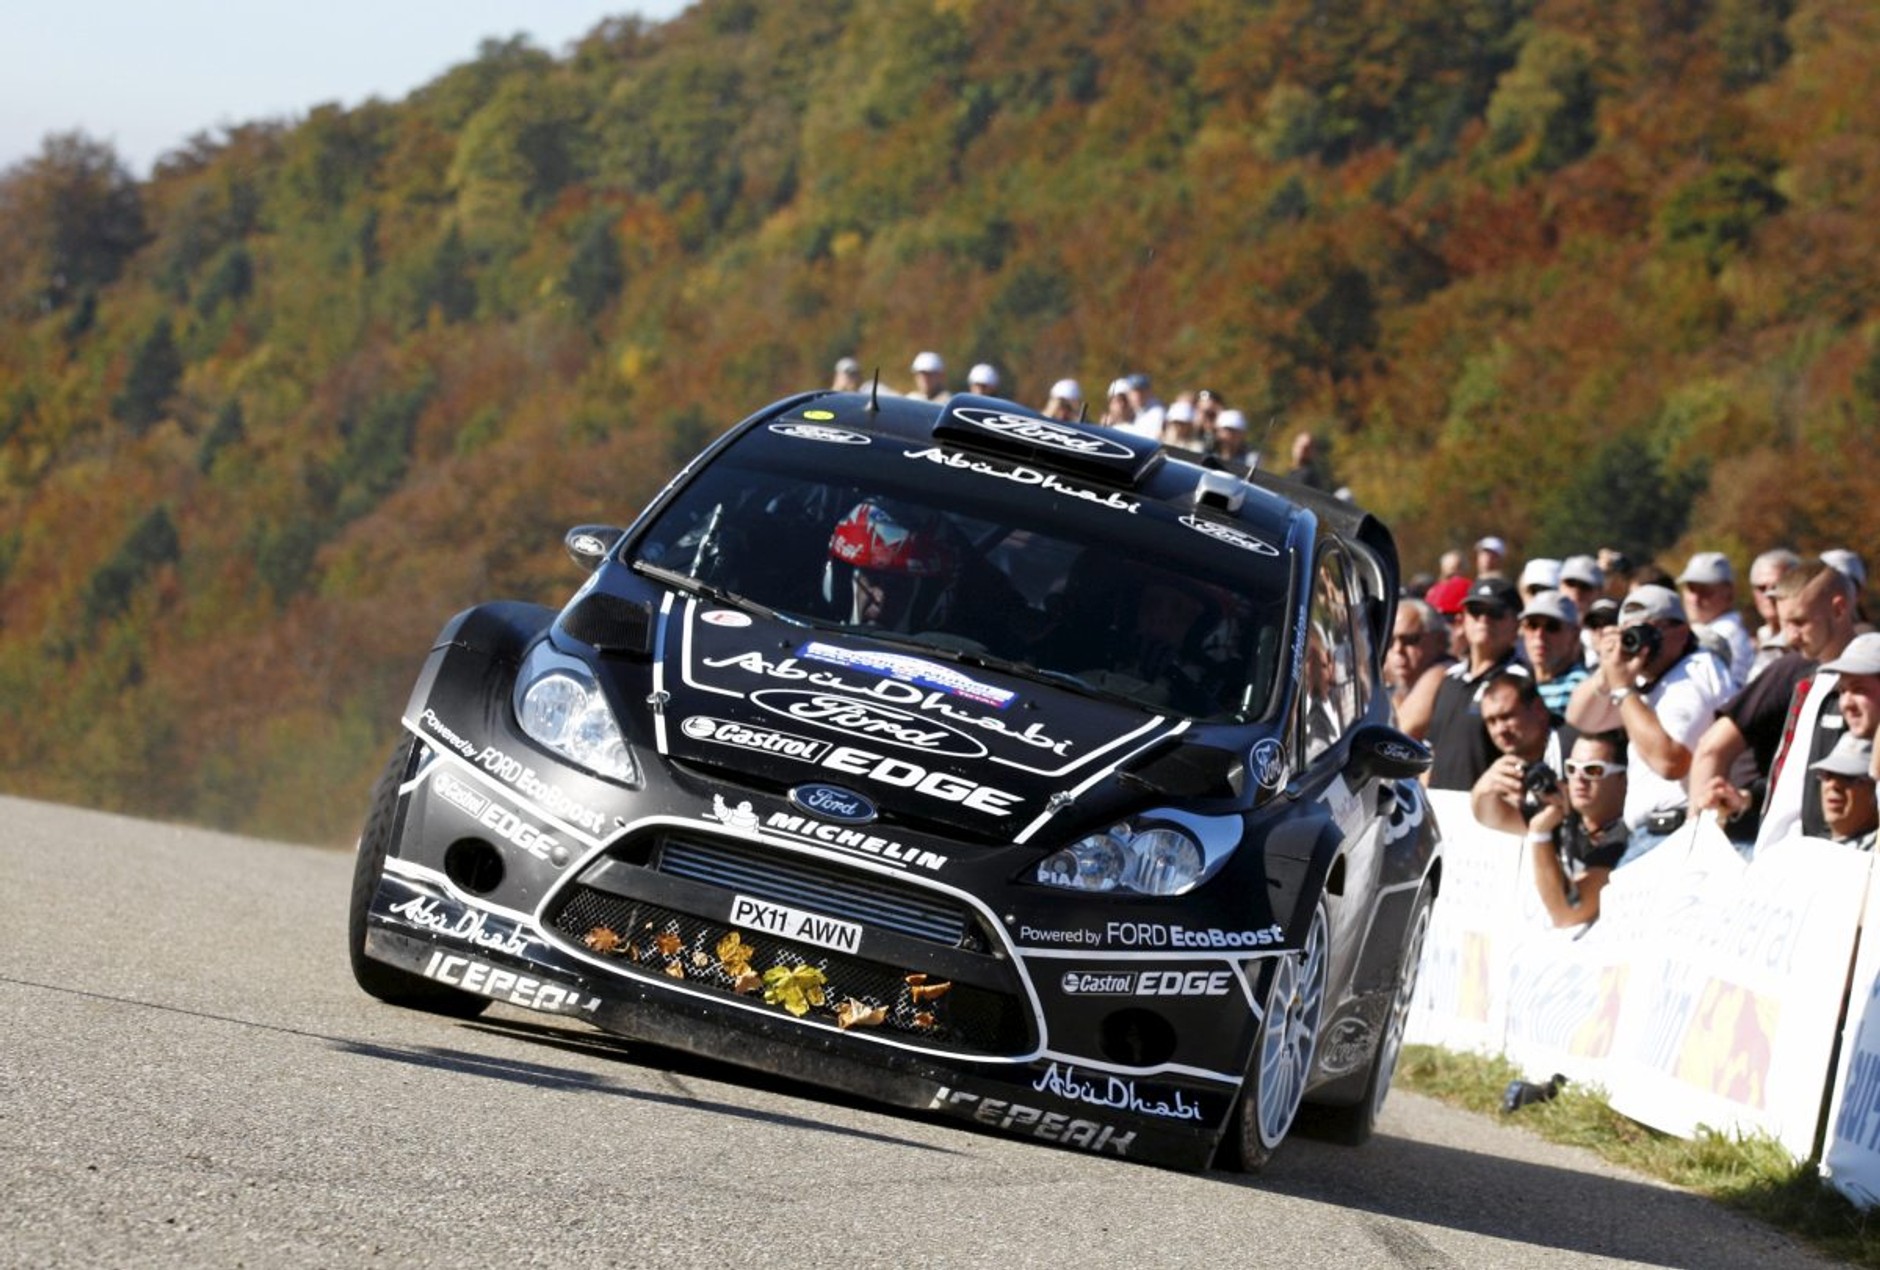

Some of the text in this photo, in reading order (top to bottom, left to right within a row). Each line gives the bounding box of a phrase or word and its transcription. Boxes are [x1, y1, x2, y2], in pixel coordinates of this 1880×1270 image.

[982, 415, 1104, 452] Ford
[421, 708, 470, 748] Powered
[475, 746, 523, 783] FORD
[789, 696, 947, 749] Ford
[714, 720, 1026, 816] Castrol EDGE
[808, 787, 857, 816] Ford
[480, 803, 559, 860] EDGE
[767, 811, 949, 871] MICHELIN
[1037, 869, 1085, 887] PIAA
[736, 900, 857, 949] PX11 AWN
[1020, 922, 1285, 947] Powered by FORD EcoBoost
[1078, 971, 1233, 995] Castrol EDGE
